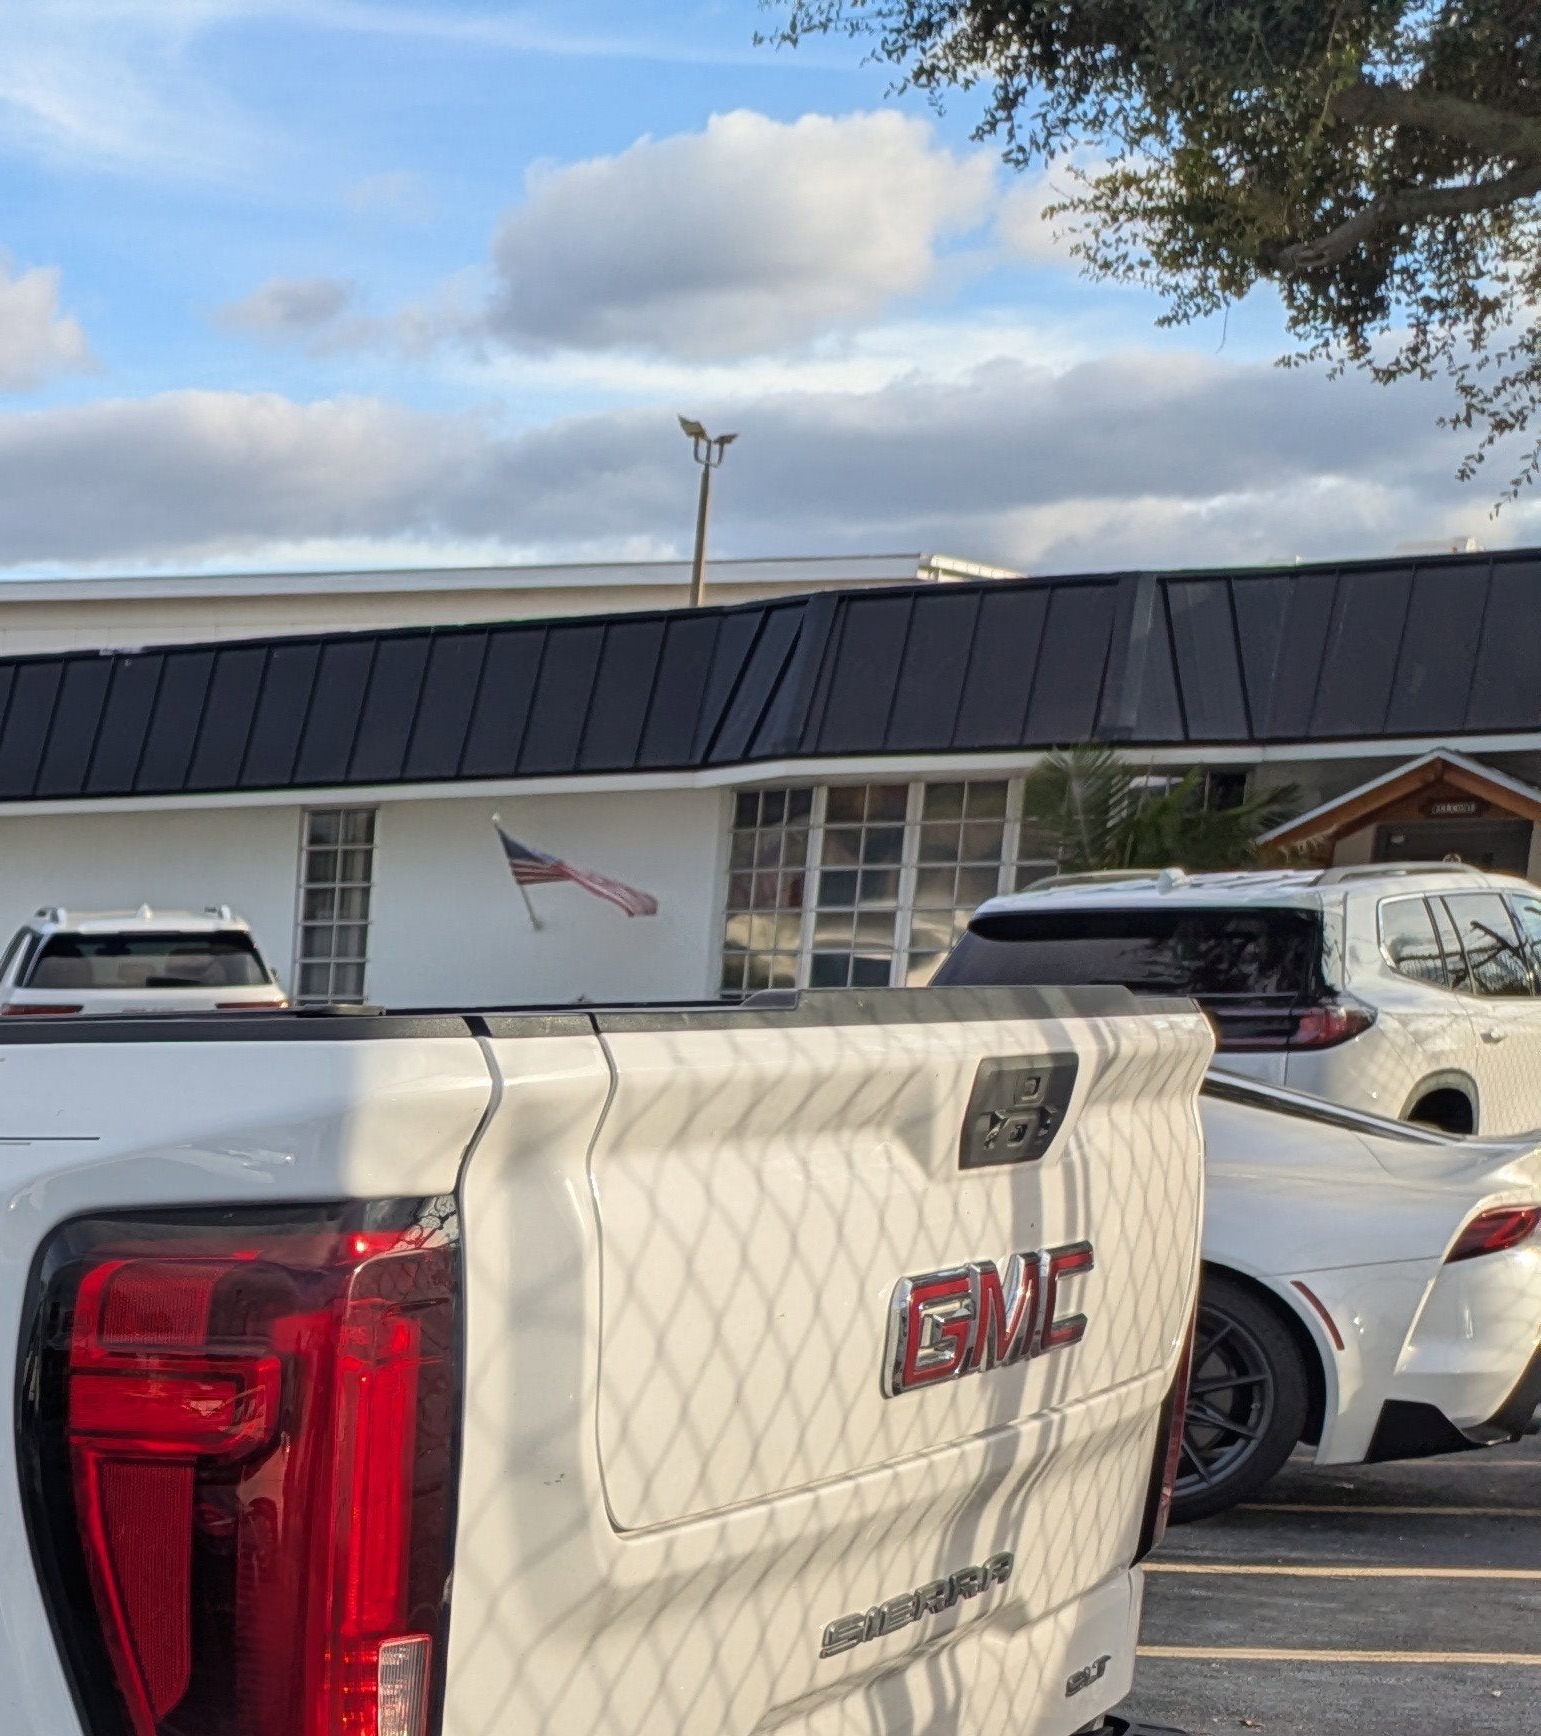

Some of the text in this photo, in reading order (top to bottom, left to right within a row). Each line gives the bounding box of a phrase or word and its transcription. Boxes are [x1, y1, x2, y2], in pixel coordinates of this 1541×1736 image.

[880, 1240, 1095, 1400] GMC
[819, 1551, 1015, 1660] SIERRA
[1065, 1654, 1112, 1697] SLT
